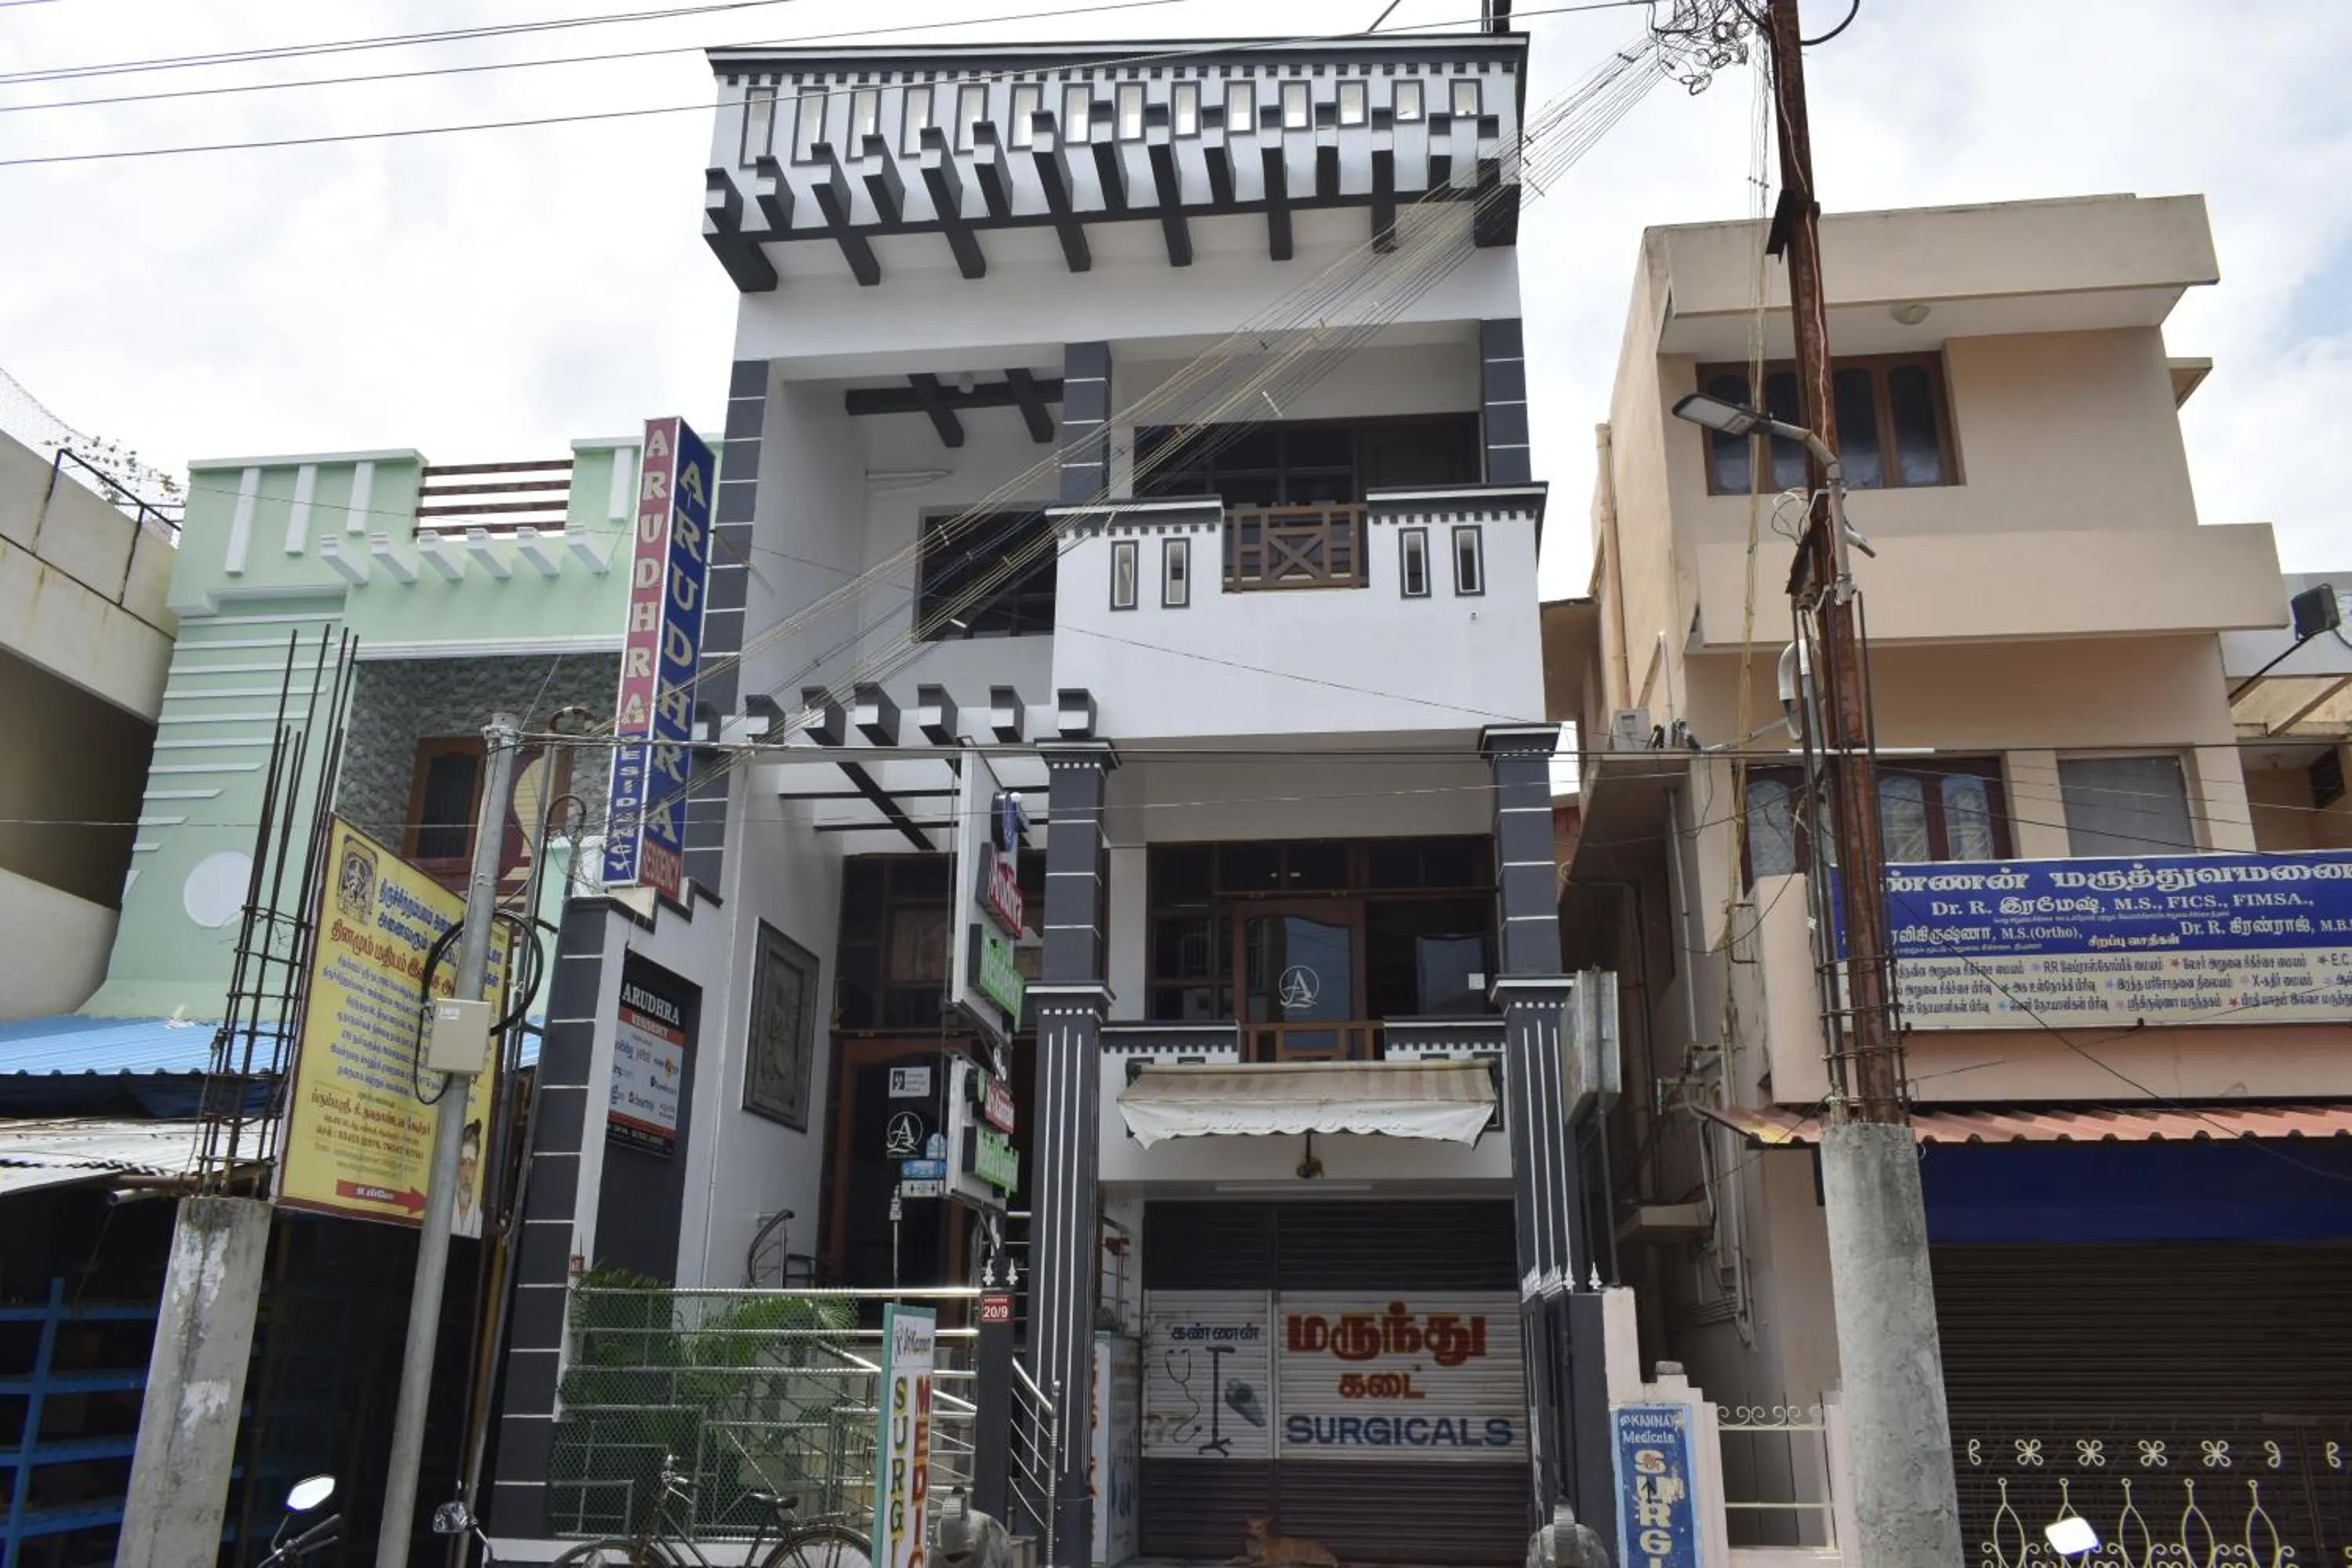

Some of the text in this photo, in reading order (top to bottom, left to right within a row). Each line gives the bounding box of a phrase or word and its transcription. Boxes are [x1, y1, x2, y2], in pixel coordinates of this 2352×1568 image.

[619, 428, 669, 724] ARUDHRA
[647, 460, 706, 844] ARUDHRA
[1880, 867, 2030, 892] ண்ணன்
[1932, 902, 1963, 916] Dr.
[1970, 901, 1992, 915] R.
[2114, 897, 2163, 912] M.S.,
[2167, 894, 2228, 909] FICS.,
[2234, 891, 2314, 907] FIMSA.,
[2180, 920, 2205, 936] Dr.
[2208, 919, 2225, 935] R.
[2320, 919, 2352, 932] M.B.
[2044, 961, 2059, 973] RR
[622, 982, 680, 1025] ARUDHRA
[982, 1305, 1007, 1318] 20/9
[1287, 1301, 1486, 1366] மருந்து
[1338, 1373, 1426, 1399] கடை
[1286, 1415, 1515, 1447] SURGICALS
[1622, 1429, 1676, 1443] Medicals
